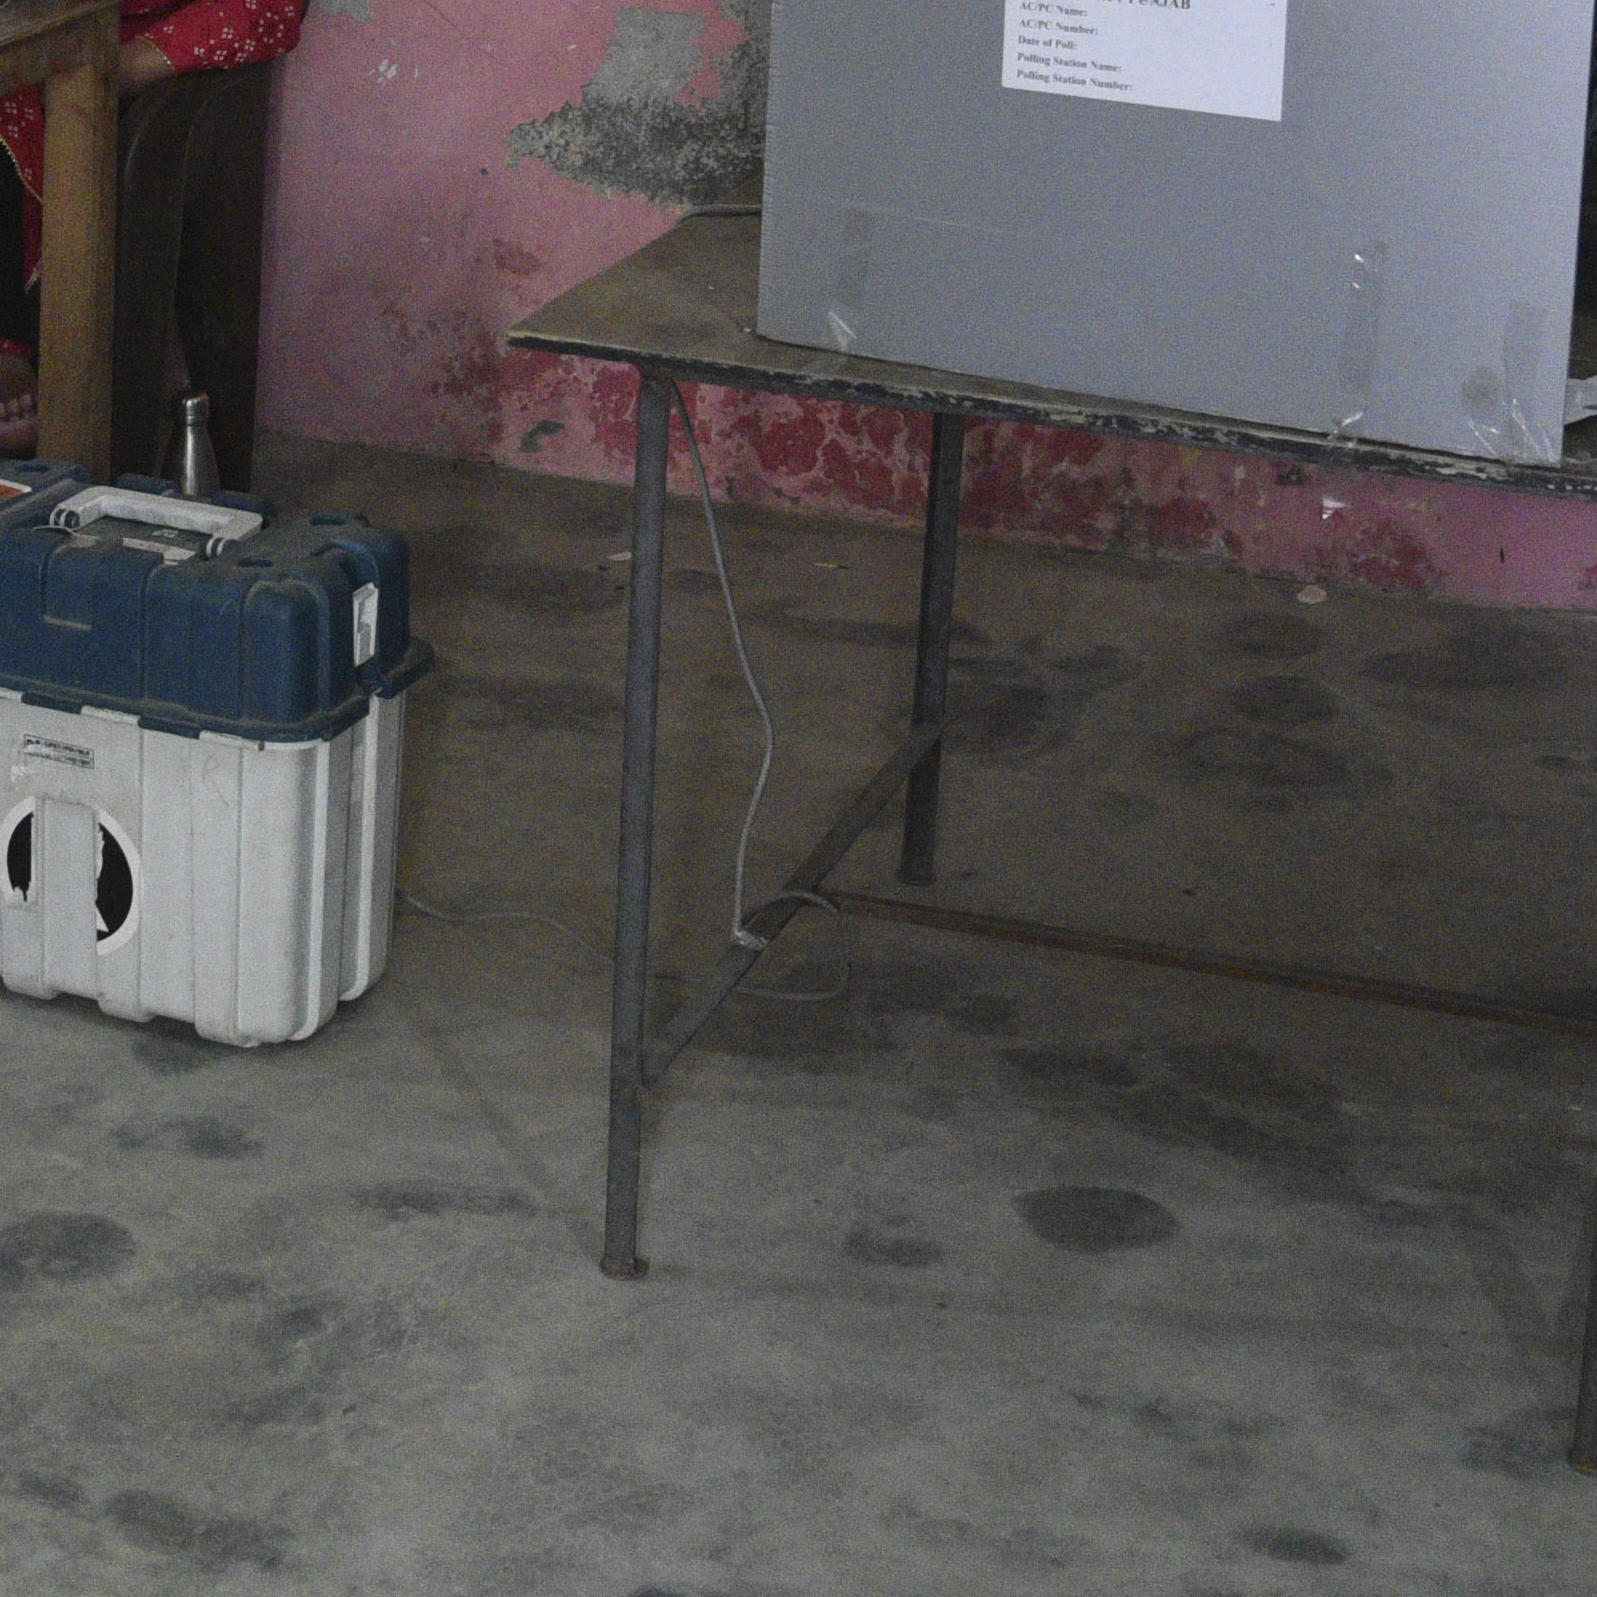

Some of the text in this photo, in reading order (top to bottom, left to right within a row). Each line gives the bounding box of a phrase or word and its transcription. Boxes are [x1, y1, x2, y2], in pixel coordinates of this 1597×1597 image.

[1056, 4, 1088, 17] Name:
[1055, 21, 1099, 36] Number:
[1017, 35, 1041, 47] Date
[1042, 38, 1054, 49] of
[1017, 52, 1051, 67] Polling
[1053, 56, 1088, 69] Station
[1016, 69, 1050, 84] Polling
[1052, 73, 1087, 86] Station
